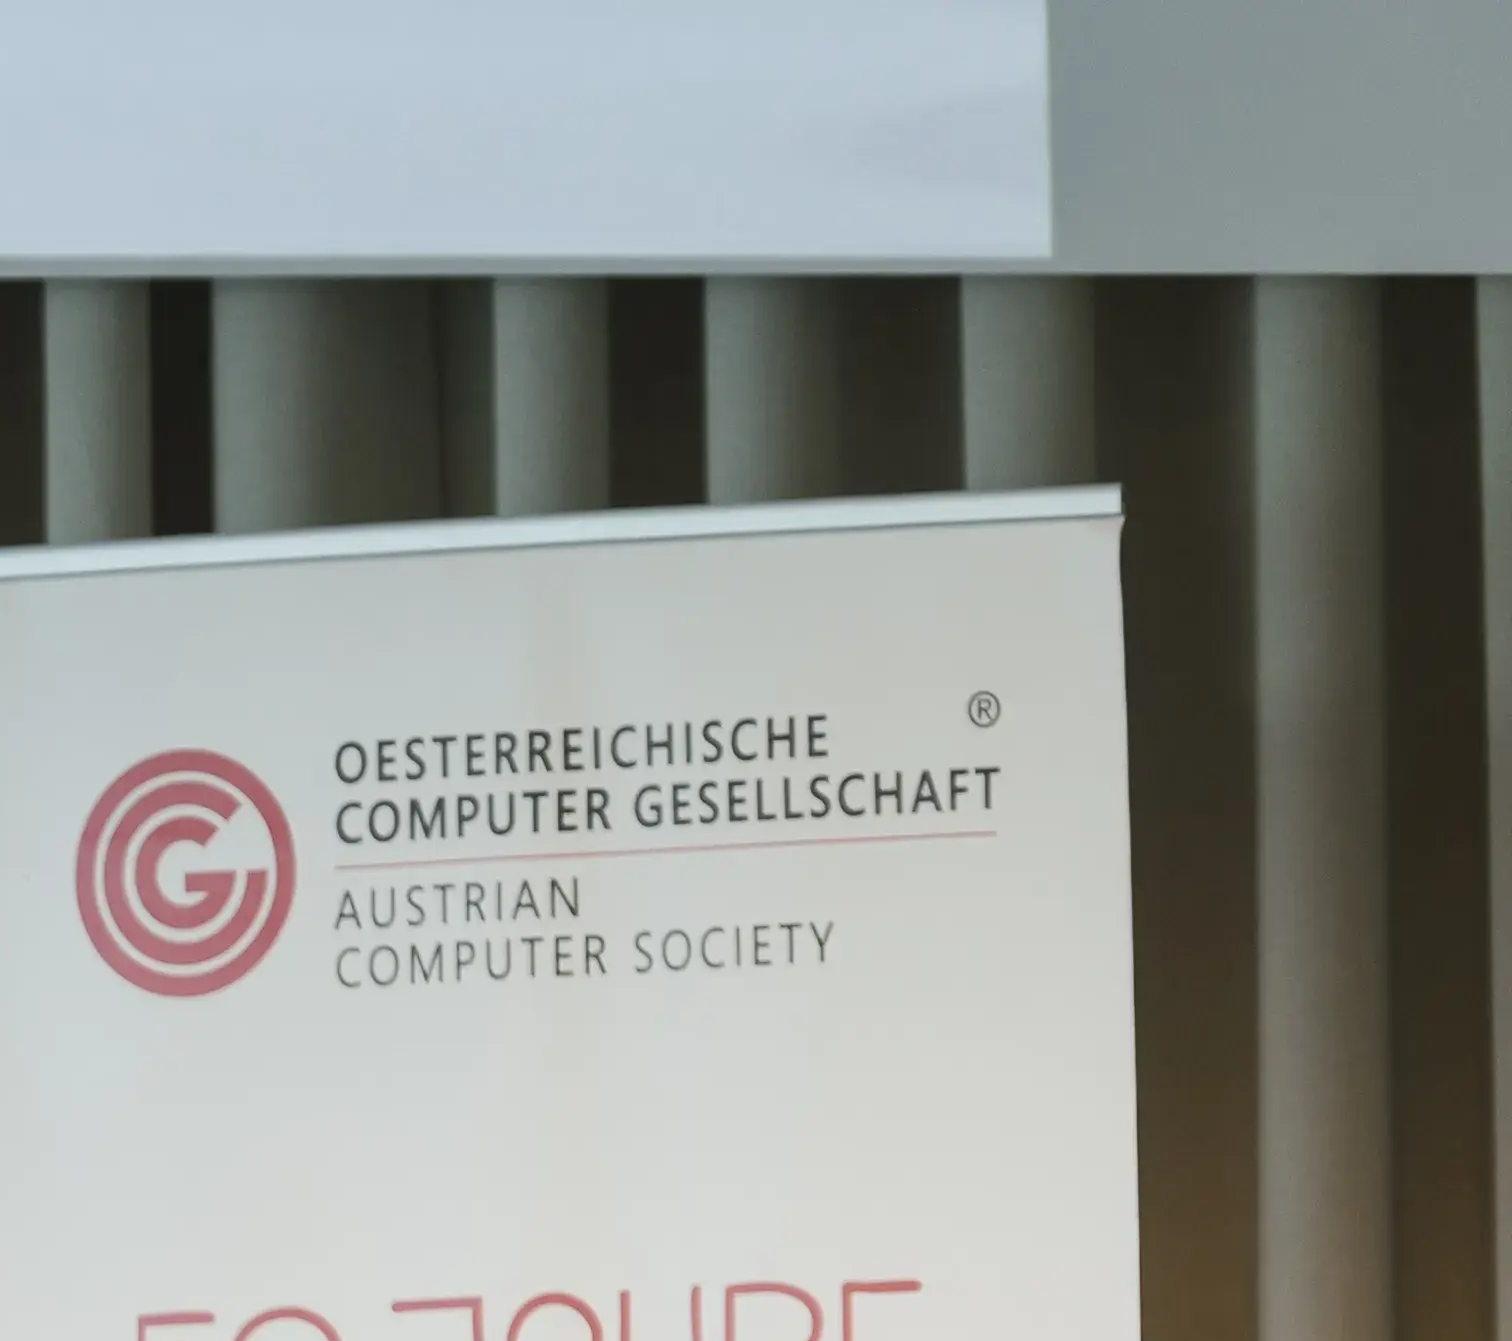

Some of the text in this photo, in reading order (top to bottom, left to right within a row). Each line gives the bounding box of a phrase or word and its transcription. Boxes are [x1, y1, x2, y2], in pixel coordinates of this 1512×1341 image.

[333, 713, 831, 785] OESTERREICHISCHE
[334, 766, 1002, 846] COMPUTER GESELLSCHAFT
[334, 877, 582, 930] AUSTRIAN
[334, 921, 837, 989] COMPUTER SOCIETY
